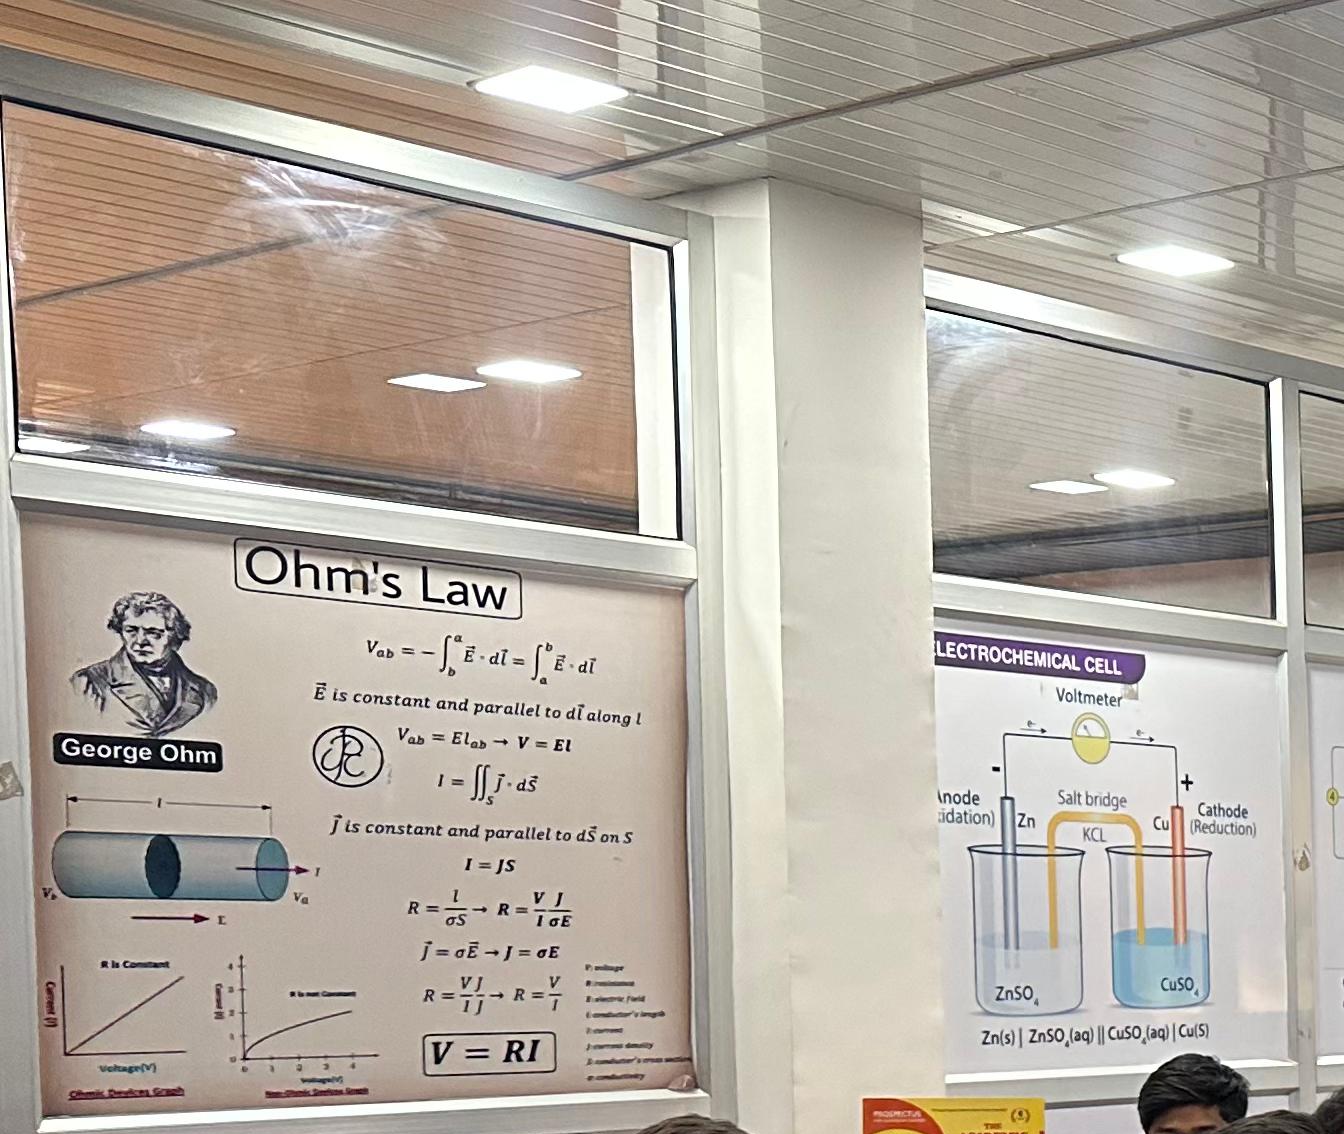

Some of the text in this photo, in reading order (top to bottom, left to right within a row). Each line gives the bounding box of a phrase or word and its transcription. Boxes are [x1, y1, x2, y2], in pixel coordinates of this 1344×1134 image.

[246, 546, 507, 610] Ohm's Law
[1084, 656, 1123, 676] CELL
[1056, 687, 1123, 708] Voltmeter
[333, 689, 347, 702] is
[353, 691, 430, 709] constant
[436, 697, 468, 712] and
[474, 700, 540, 718] parallel
[546, 706, 561, 719] to
[587, 709, 631, 727] along
[61, 738, 217, 765] George Ohm
[1058, 790, 1127, 810] Salt bridge
[1017, 812, 1035, 828] Zn
[1197, 803, 1248, 820] Cathode
[345, 820, 359, 833] is
[365, 822, 442, 837] constant
[448, 825, 480, 839] and
[485, 827, 551, 842] parallel
[555, 829, 571, 841] to
[600, 833, 619, 844] on
[1153, 816, 1169, 831] Cu
[1190, 819, 1256, 837] (Reduction)
[1083, 828, 1107, 843] KCL
[981, 1030, 1015, 1046] Zn(s)
[431, 1041, 454, 1066] V
[502, 1039, 540, 1064] RI
